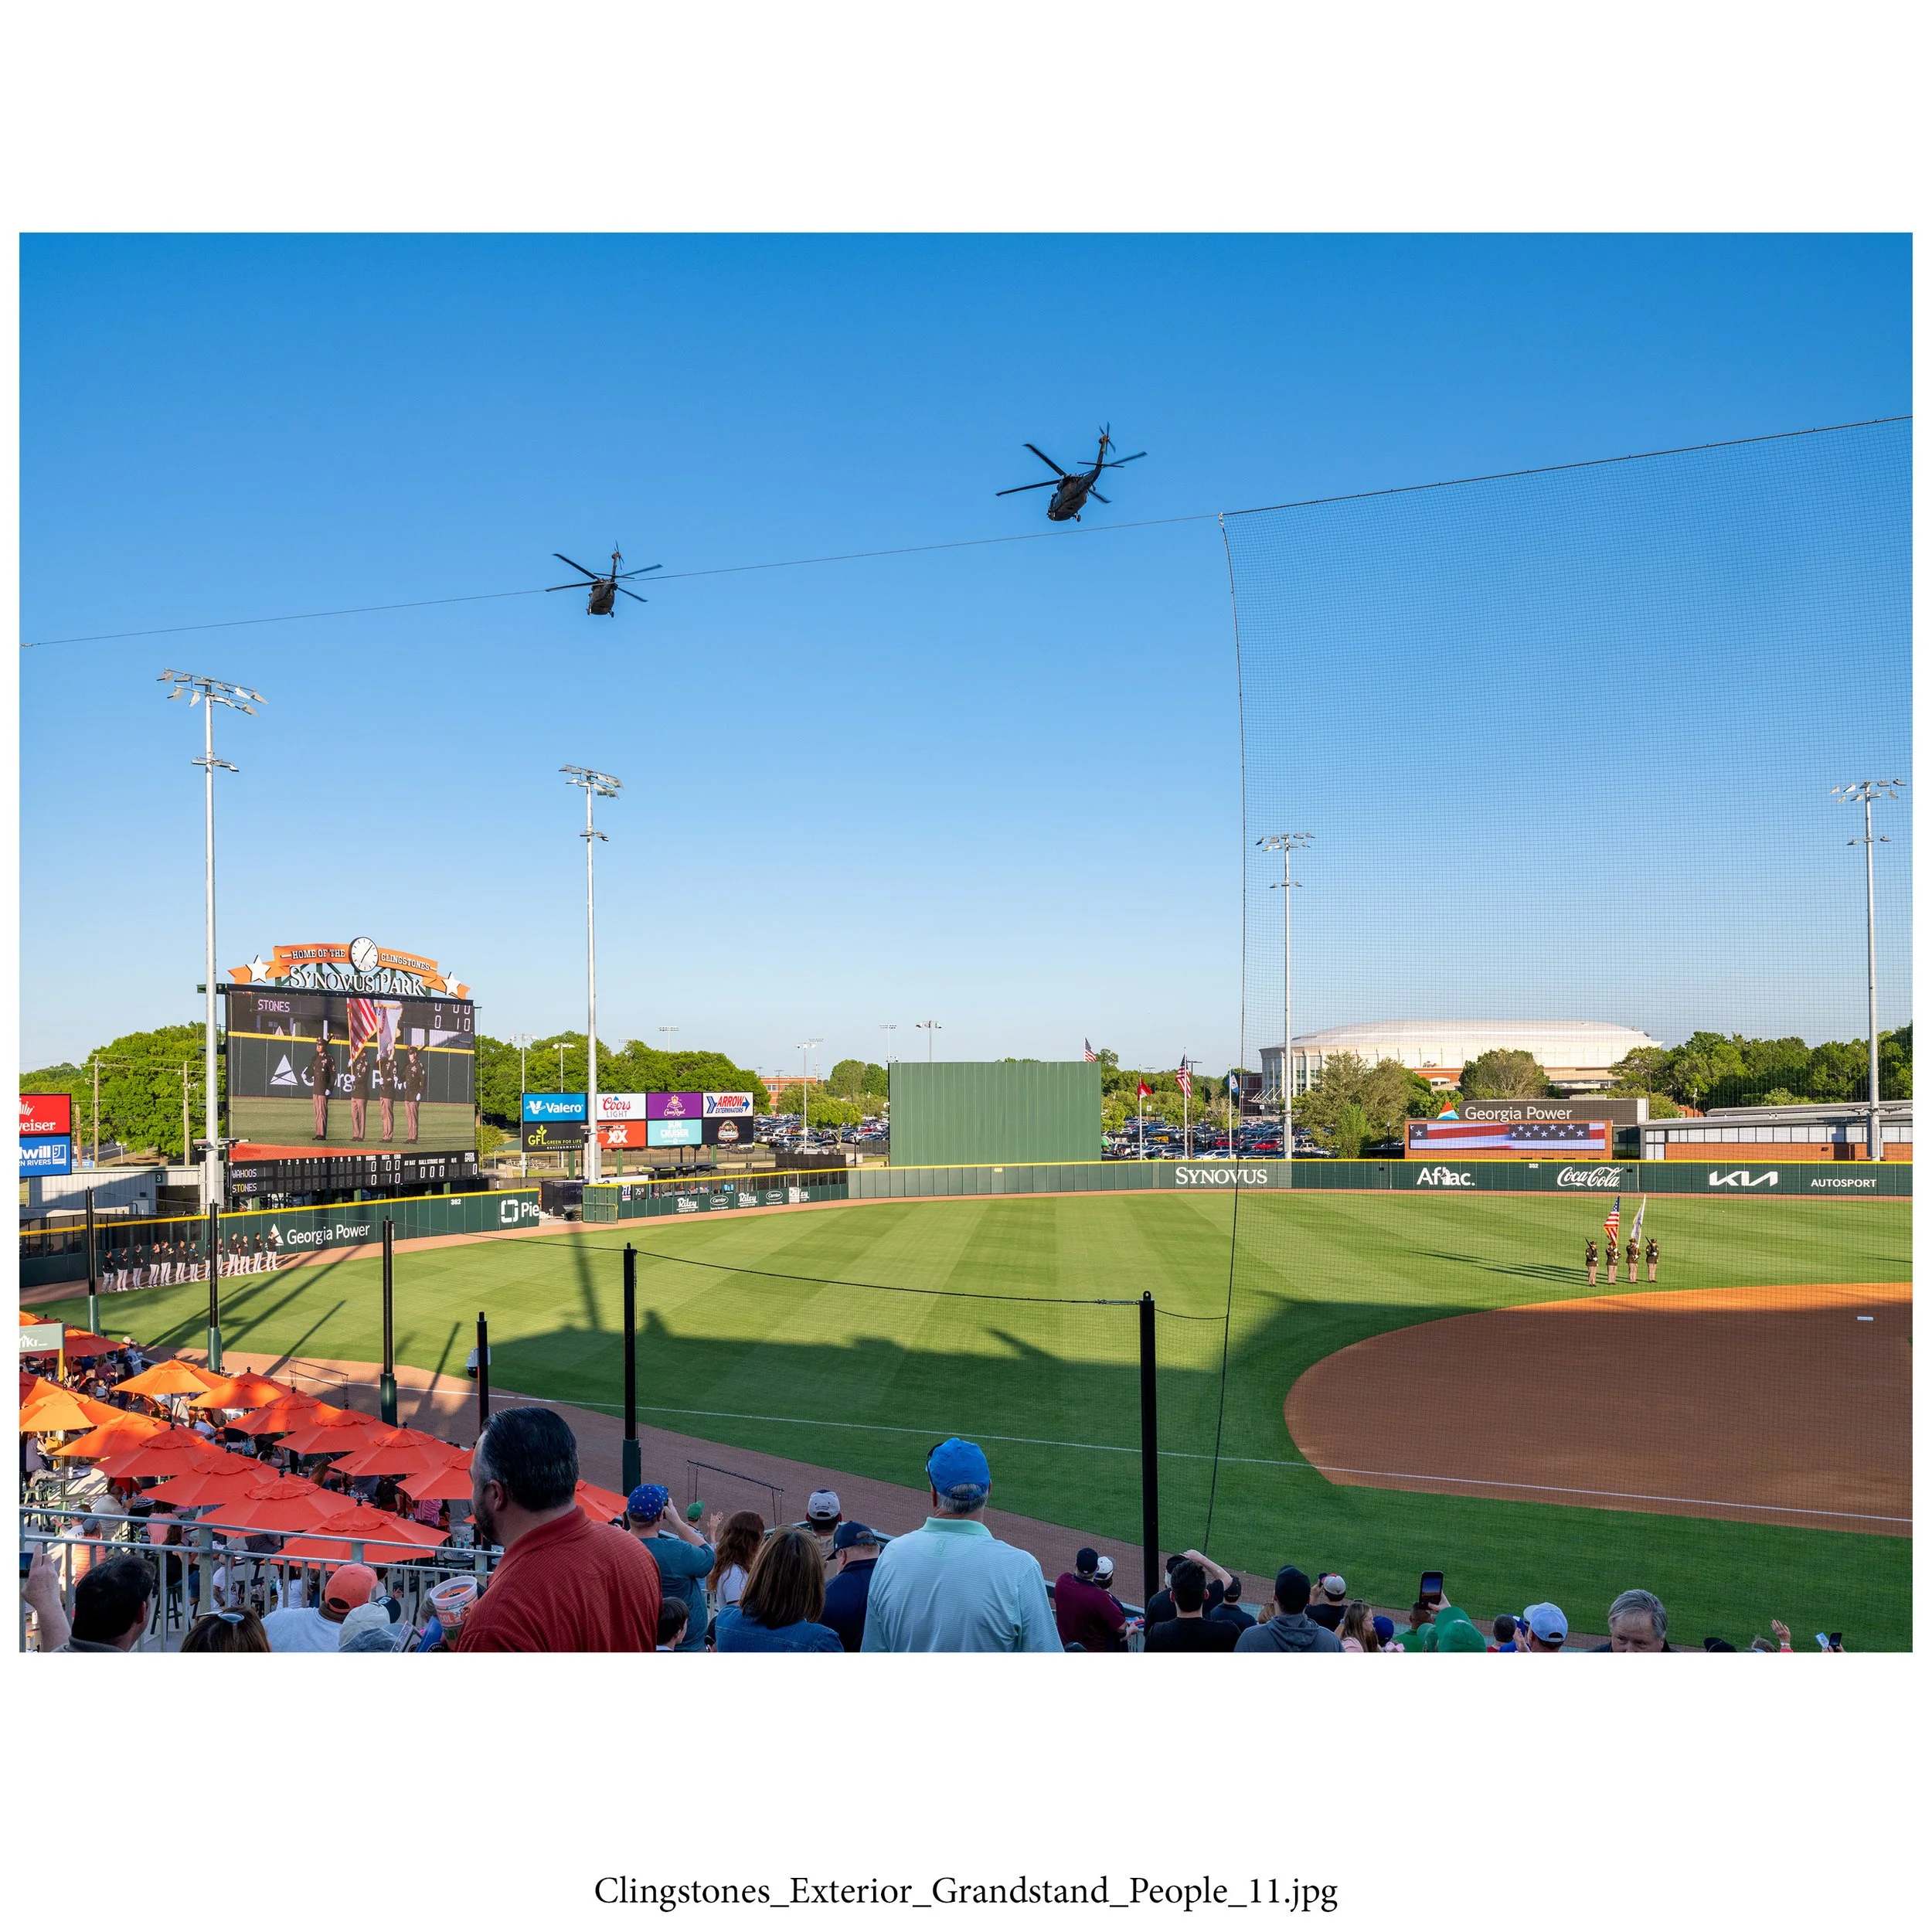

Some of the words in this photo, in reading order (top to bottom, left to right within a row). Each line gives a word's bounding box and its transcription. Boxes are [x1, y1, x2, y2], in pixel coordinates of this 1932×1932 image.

[291, 949, 317, 960] HOME
[318, 949, 328, 958] OF
[328, 948, 345, 958] THE
[379, 953, 430, 971] CLINGSTONES
[289, 965, 375, 993] SYNOVUS
[379, 971, 425, 996] PARK
[257, 998, 291, 1012] STONES
[603, 1097, 631, 1111] Coors
[717, 1095, 745, 1107] ARROW
[546, 1102, 582, 1114] Valero
[606, 1110, 628, 1118] LIGHT
[1464, 1107, 1522, 1123] Georgia
[1527, 1106, 1573, 1120] Power
[528, 1134, 547, 1145] GFL
[607, 1129, 628, 1144] XX
[157, 1174, 162, 1182] 3
[1175, 1166, 1267, 1185] SYNOVUS
[1557, 1166, 1624, 1188] Coca-Cola
[1709, 1170, 1778, 1187] KIA
[232, 1182, 257, 1193] STONES
[1811, 1179, 1877, 1188] AUTOSPORT
[677, 1197, 697, 1209] Riley
[738, 1192, 757, 1203] Riley
[287, 1223, 333, 1246] Georgia
[336, 1223, 370, 1240] Power
